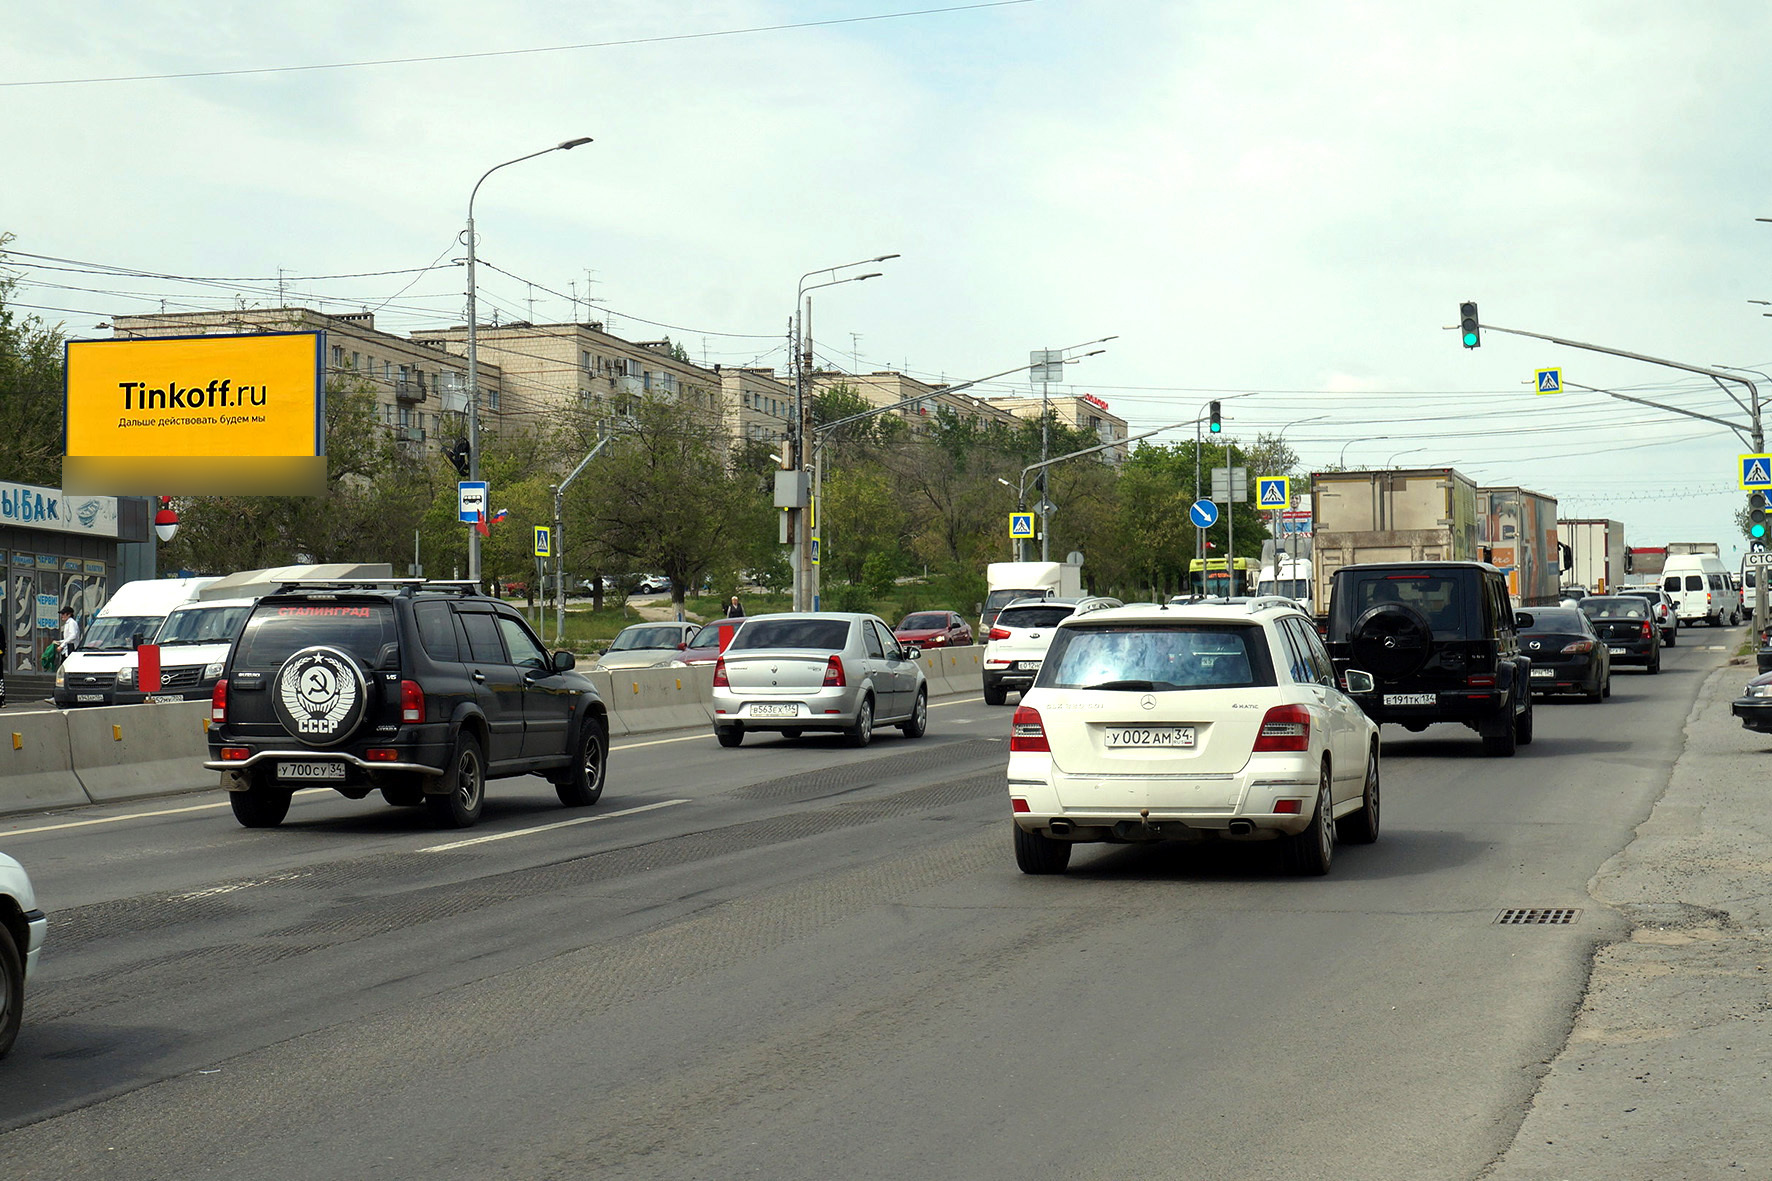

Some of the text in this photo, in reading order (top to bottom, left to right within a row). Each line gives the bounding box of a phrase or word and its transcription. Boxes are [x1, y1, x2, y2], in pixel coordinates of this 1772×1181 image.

[119, 379, 266, 410] Tinkoff.ru
[118, 414, 266, 428] Дальше действовать будем мы
[37, 595, 58, 606] ЧЕРВИ!
[278, 607, 370, 617] СТАЛИНГРАД
[37, 618, 58, 628] ЧЕРВИ!
[298, 719, 338, 733] СССР
